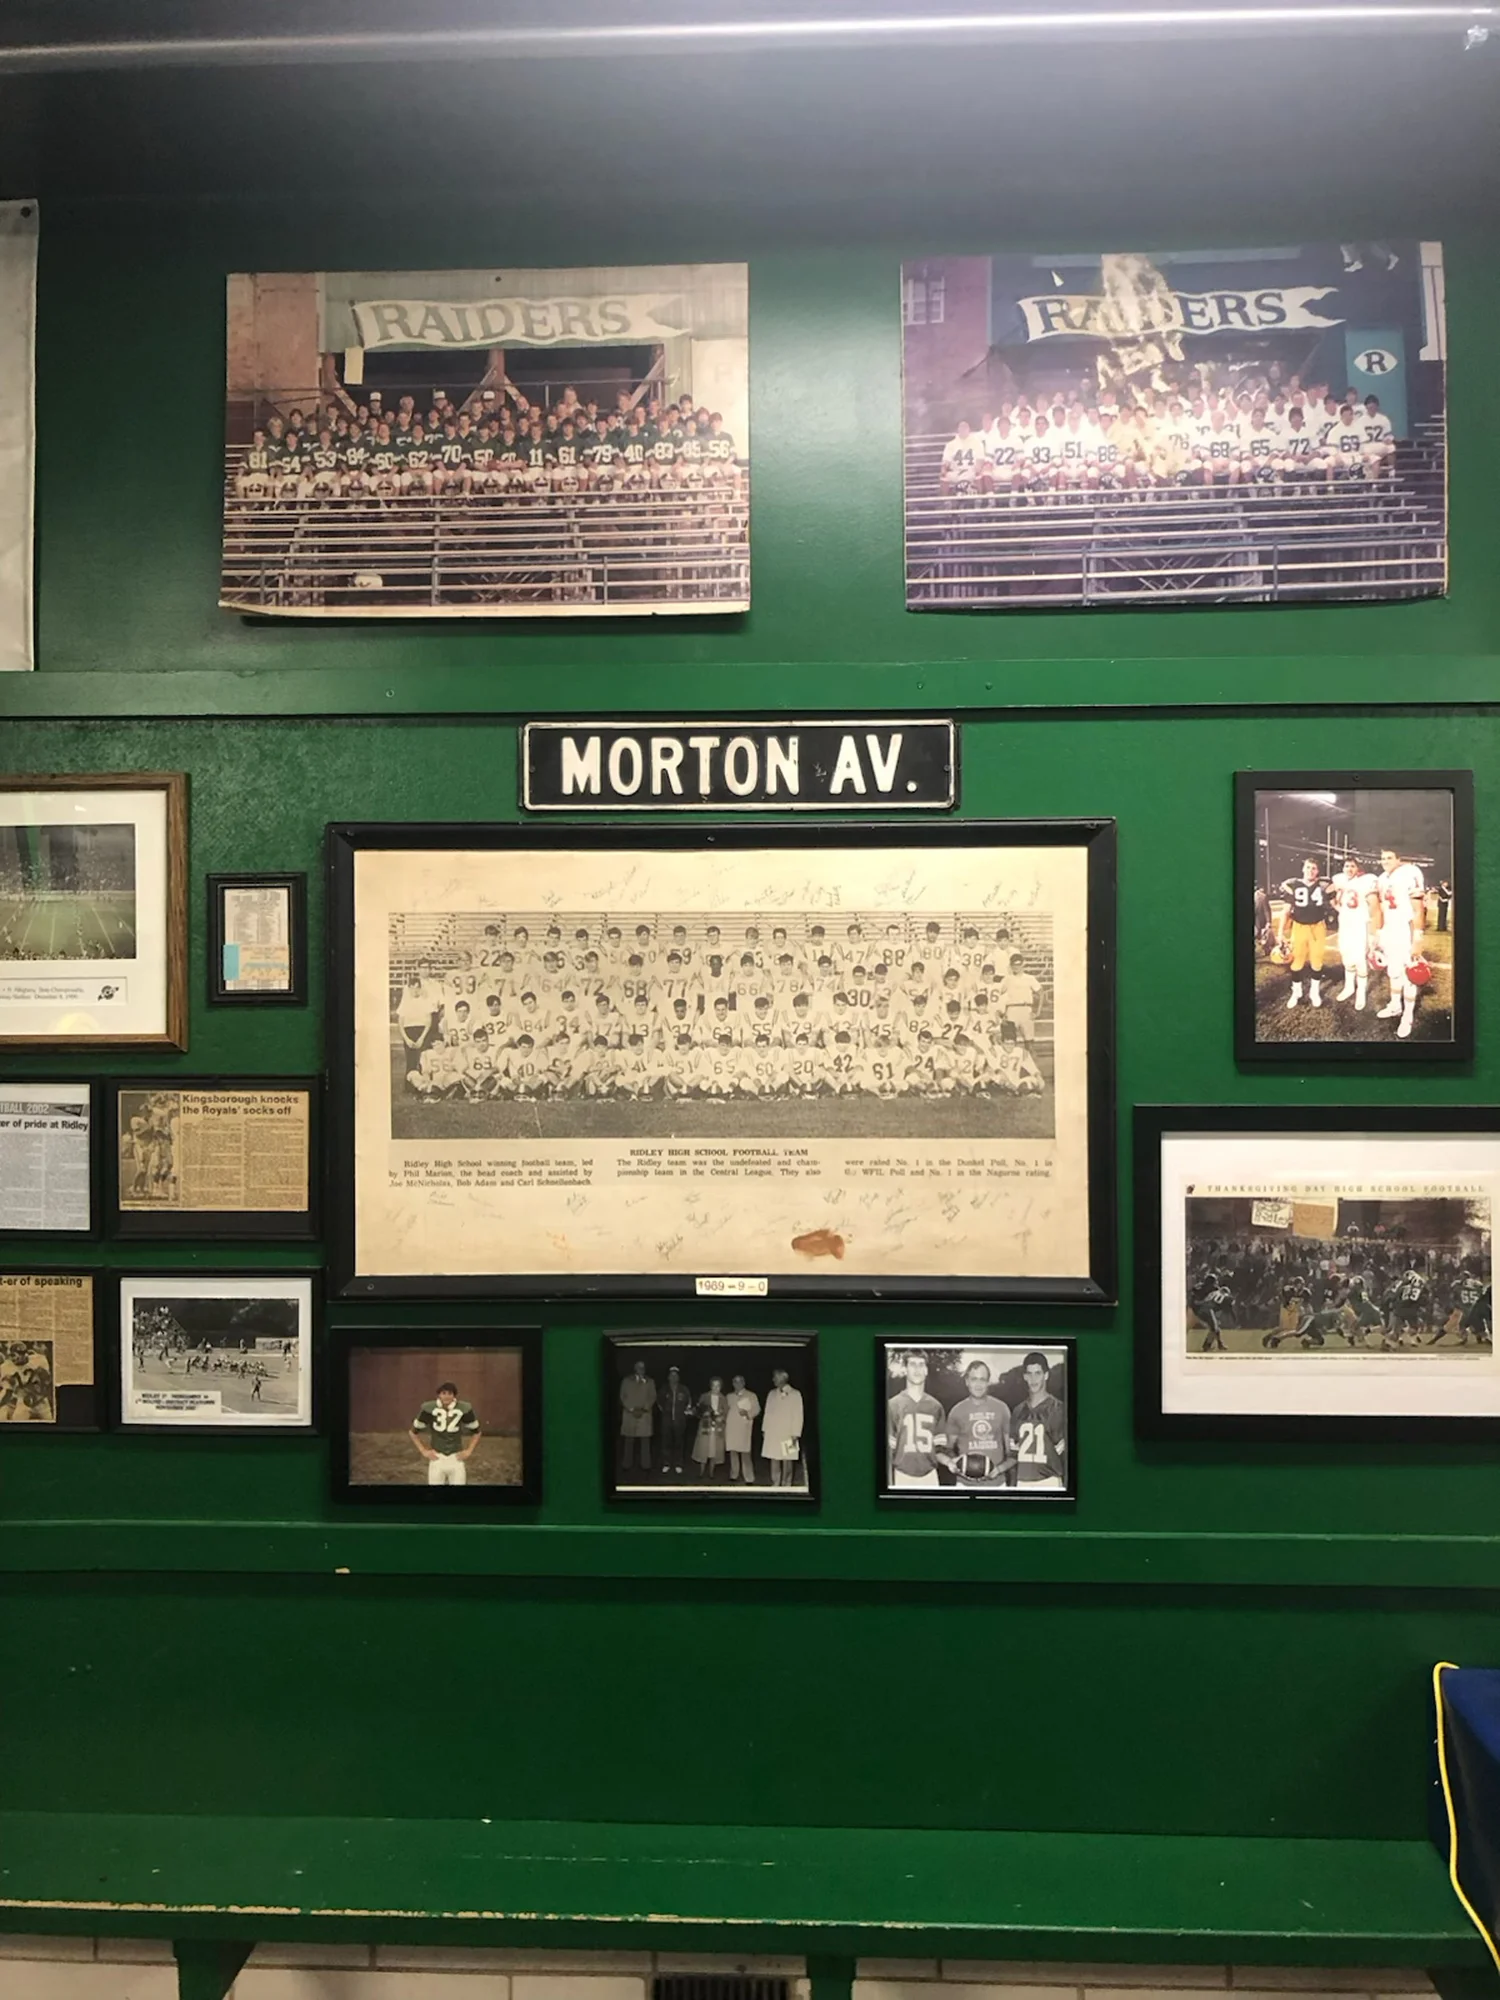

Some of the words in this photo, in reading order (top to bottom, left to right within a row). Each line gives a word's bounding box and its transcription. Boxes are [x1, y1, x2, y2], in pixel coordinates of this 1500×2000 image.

[369, 299, 632, 343] RAIDERS
[1365, 351, 1389, 373] R
[441, 445, 462, 464] 70
[559, 446, 576, 465] 61
[624, 444, 643, 463] 40
[1065, 441, 1083, 459] 51
[1252, 439, 1270, 457] 65
[1289, 438, 1310, 456] 72
[249, 451, 267, 469] 81
[313, 451, 337, 468] 53
[529, 449, 543, 467] 11
[954, 448, 974, 466] 44
[995, 447, 1014, 466] 22
[562, 736, 799, 796] MORTON
[829, 734, 918, 795] AV.
[1295, 887, 1323, 907] 94
[480, 949, 500, 968] 22
[882, 948, 905, 968] 88
[848, 988, 871, 1008] 30
[182, 1094, 258, 1106] Kingsborough
[260, 1095, 299, 1104] knocks
[182, 1106, 200, 1115] the
[243, 1106, 275, 1115] socks
[276, 1106, 292, 1115] off
[12, 1119, 22, 1128] of
[24, 1120, 48, 1130] pride
[50, 1120, 59, 1129] at
[61, 1121, 88, 1132] Ridley
[630, 1149, 664, 1157] RIDLEY
[668, 1149, 691, 1157] HIGH
[694, 1149, 728, 1157] SCHOOL
[733, 1149, 779, 1157] FOOTBALL
[404, 1160, 430, 1169] Ridley
[434, 1160, 453, 1169] High
[636, 1159, 662, 1168] Ridley
[692, 1168, 705, 1176] the
[710, 1168, 739, 1176] Central
[805, 1168, 822, 1176] also
[460, 1169, 473, 1177] the
[1207, 1185, 1298, 1193] THANKSGIVING
[1305, 1185, 1326, 1193] DAY
[1334, 1185, 1363, 1193] HIGH
[1370, 1185, 1416, 1193] SCHOOL
[1423, 1184, 1485, 1193] FOOTBALL
[19, 1276, 31, 1286] of
[34, 1277, 83, 1288] speaking
[432, 1408, 465, 1432] 32
[903, 1413, 935, 1453] 15
[1017, 1422, 1048, 1463] 21
